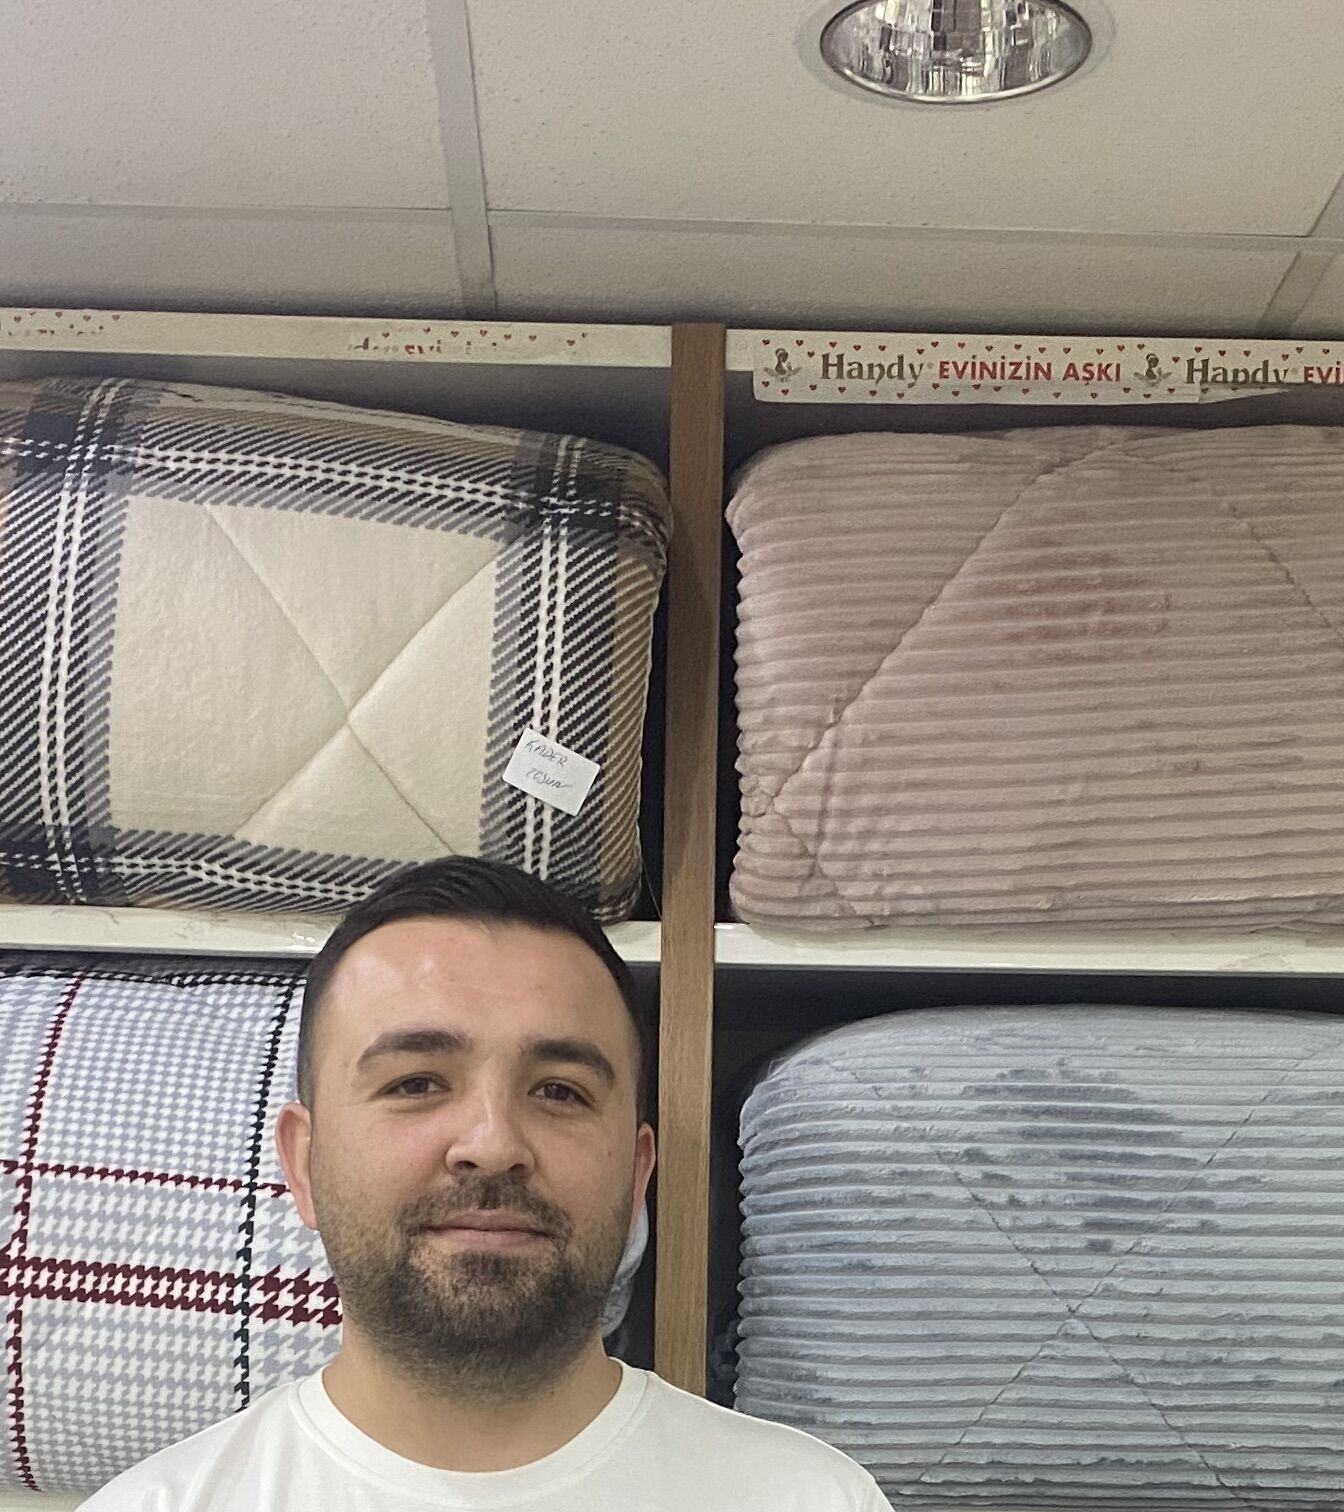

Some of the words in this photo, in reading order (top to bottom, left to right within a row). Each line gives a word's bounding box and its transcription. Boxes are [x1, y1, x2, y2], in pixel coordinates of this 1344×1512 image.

[820, 353, 925, 388] Handy
[938, 355, 1052, 381] EVİNİZİN
[1061, 361, 1122, 386] AŞKI
